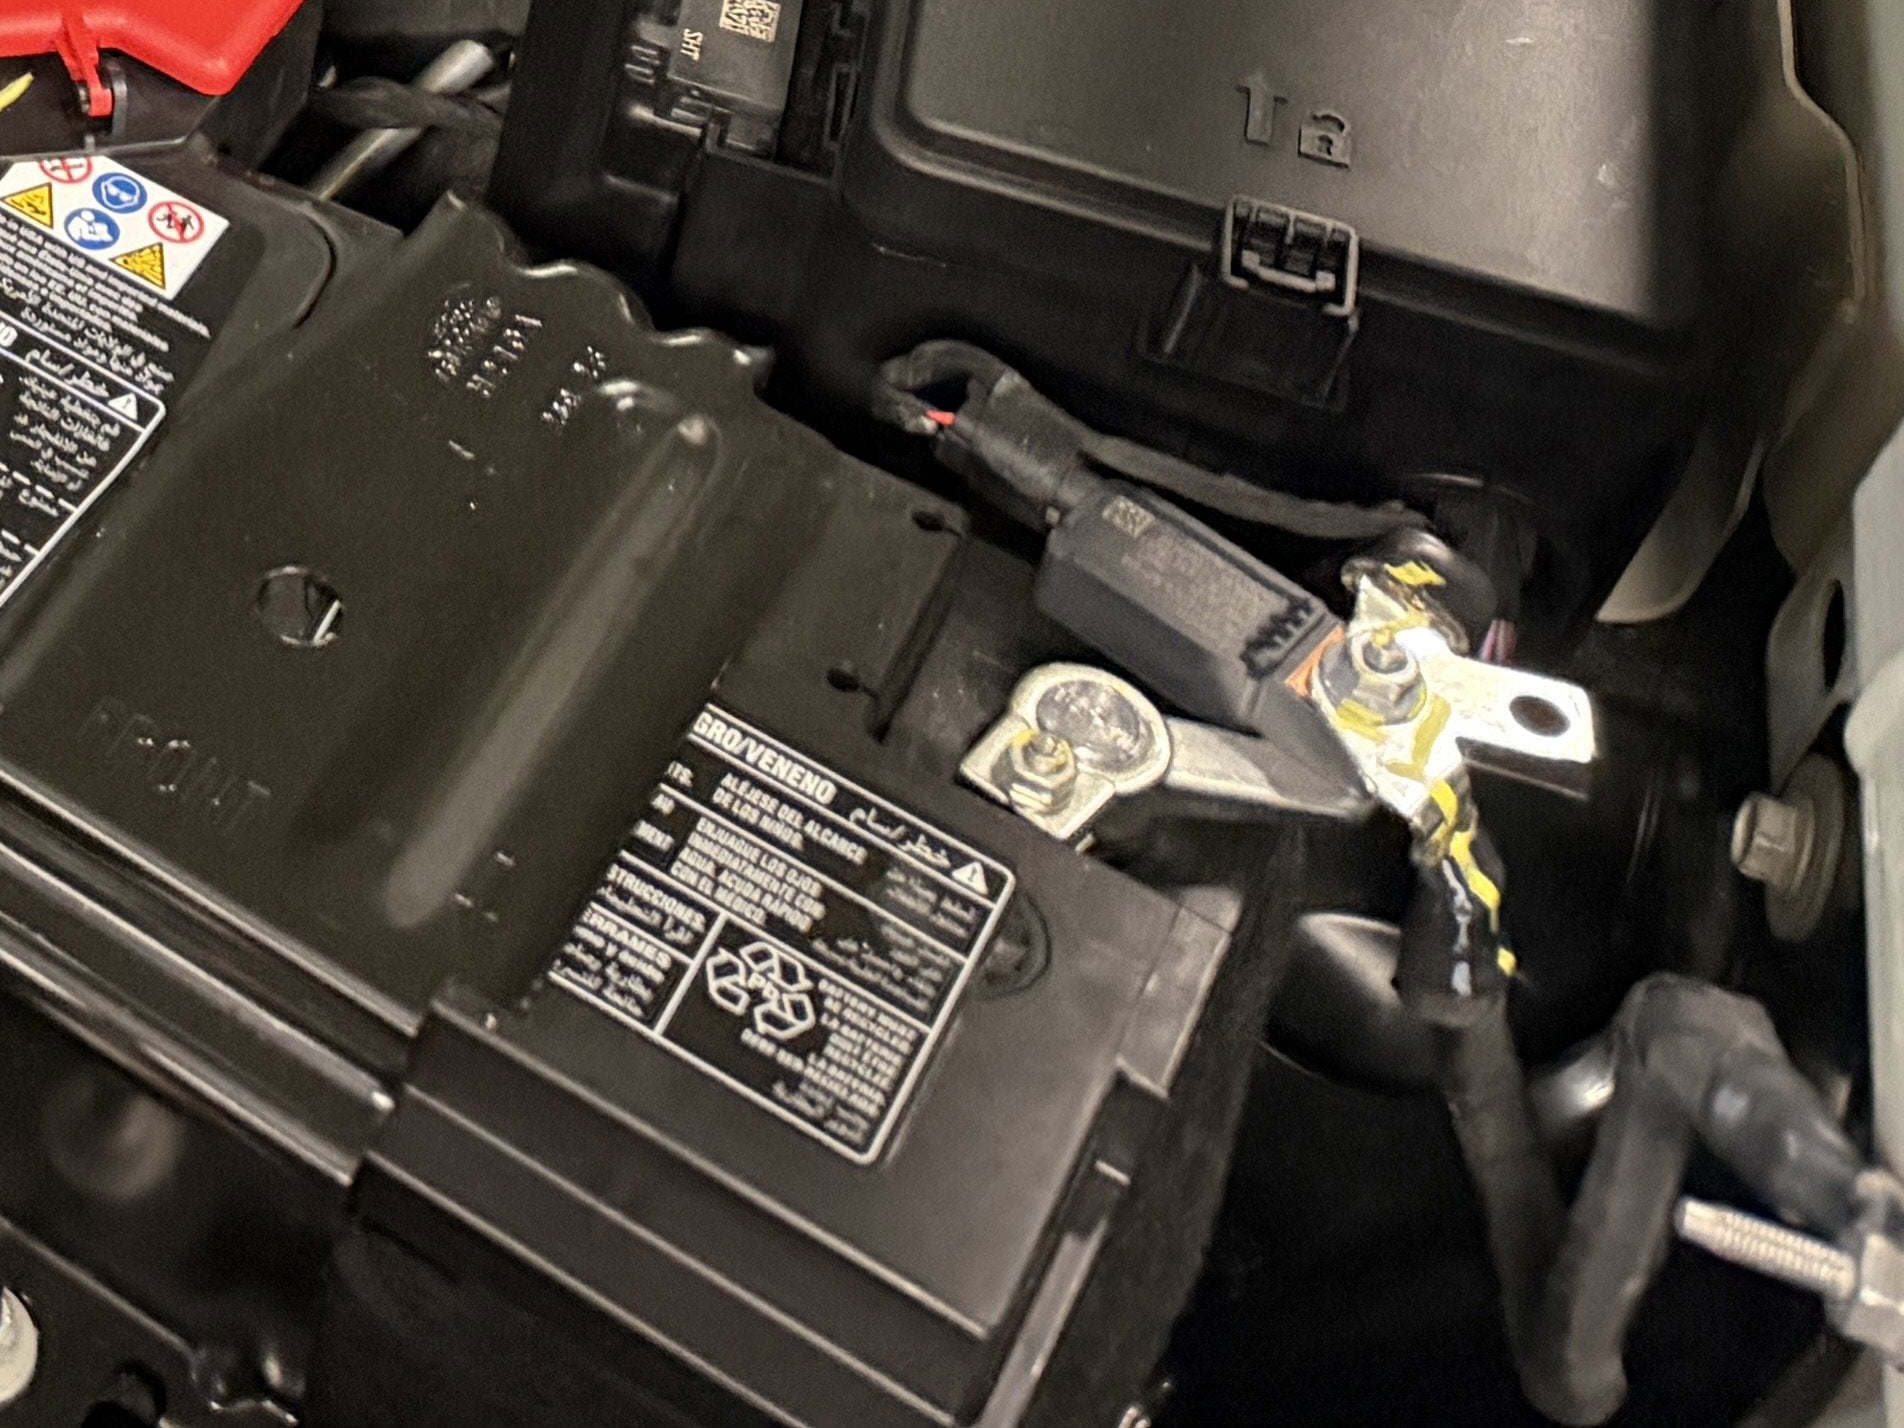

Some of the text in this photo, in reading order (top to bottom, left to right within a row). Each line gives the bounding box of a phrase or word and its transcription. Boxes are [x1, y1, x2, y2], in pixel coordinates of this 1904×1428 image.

[690, 712, 839, 807] GRO/VENENO
[710, 785, 735, 808] DE
[730, 797, 761, 824] LOS
